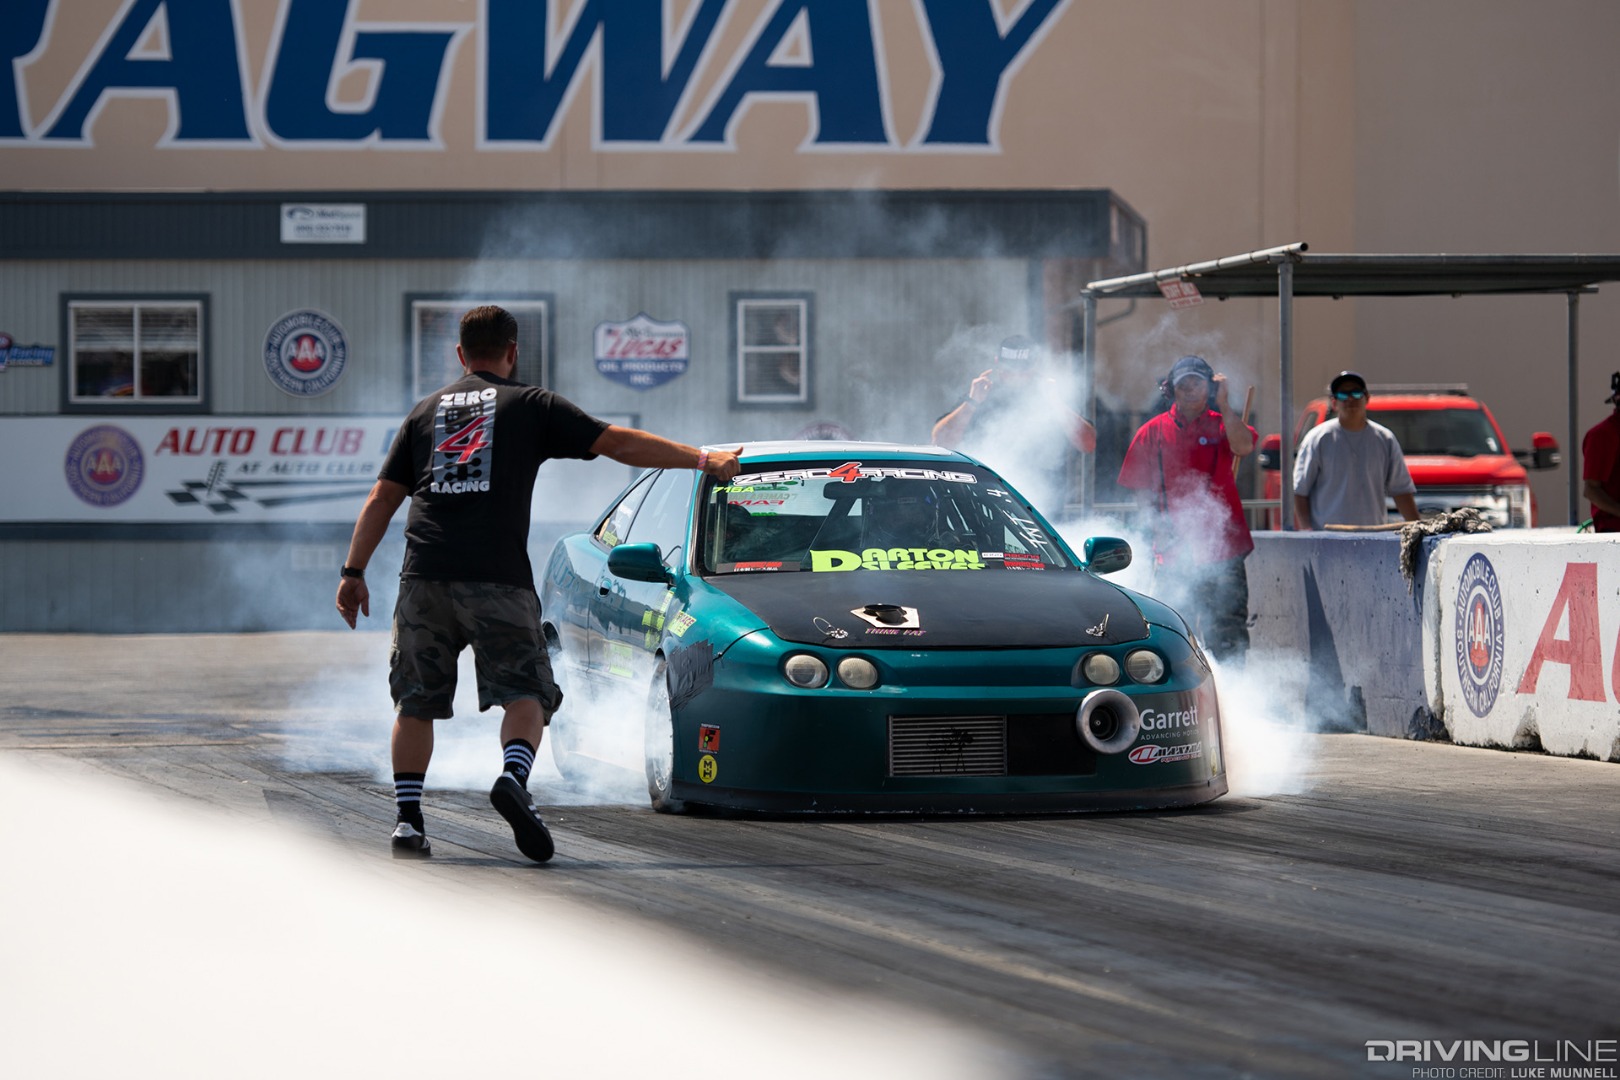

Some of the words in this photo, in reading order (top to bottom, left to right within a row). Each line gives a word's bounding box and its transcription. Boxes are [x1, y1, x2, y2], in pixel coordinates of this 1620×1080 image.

[286, 337, 325, 363] AAA
[606, 330, 683, 358] LUCAS
[622, 362, 684, 373] PRODUCTS
[440, 387, 498, 407] ZERO
[156, 427, 257, 456] AUTO
[269, 427, 367, 456] CLUB
[435, 415, 491, 464] 4
[430, 480, 491, 494] RACING
[809, 547, 980, 573] DARTON
[861, 560, 986, 571] SLEEVES
[1457, 558, 1490, 619] AUTOMOBILE
[1487, 576, 1502, 621] CLUB
[1468, 607, 1492, 651] AAA
[1517, 561, 1620, 704] A
[1456, 630, 1479, 713] SOUTHERN
[1479, 632, 1504, 714] CALIFORNIA
[1140, 705, 1199, 731] Garrett
[1141, 731, 1181, 740] ADVANCING
